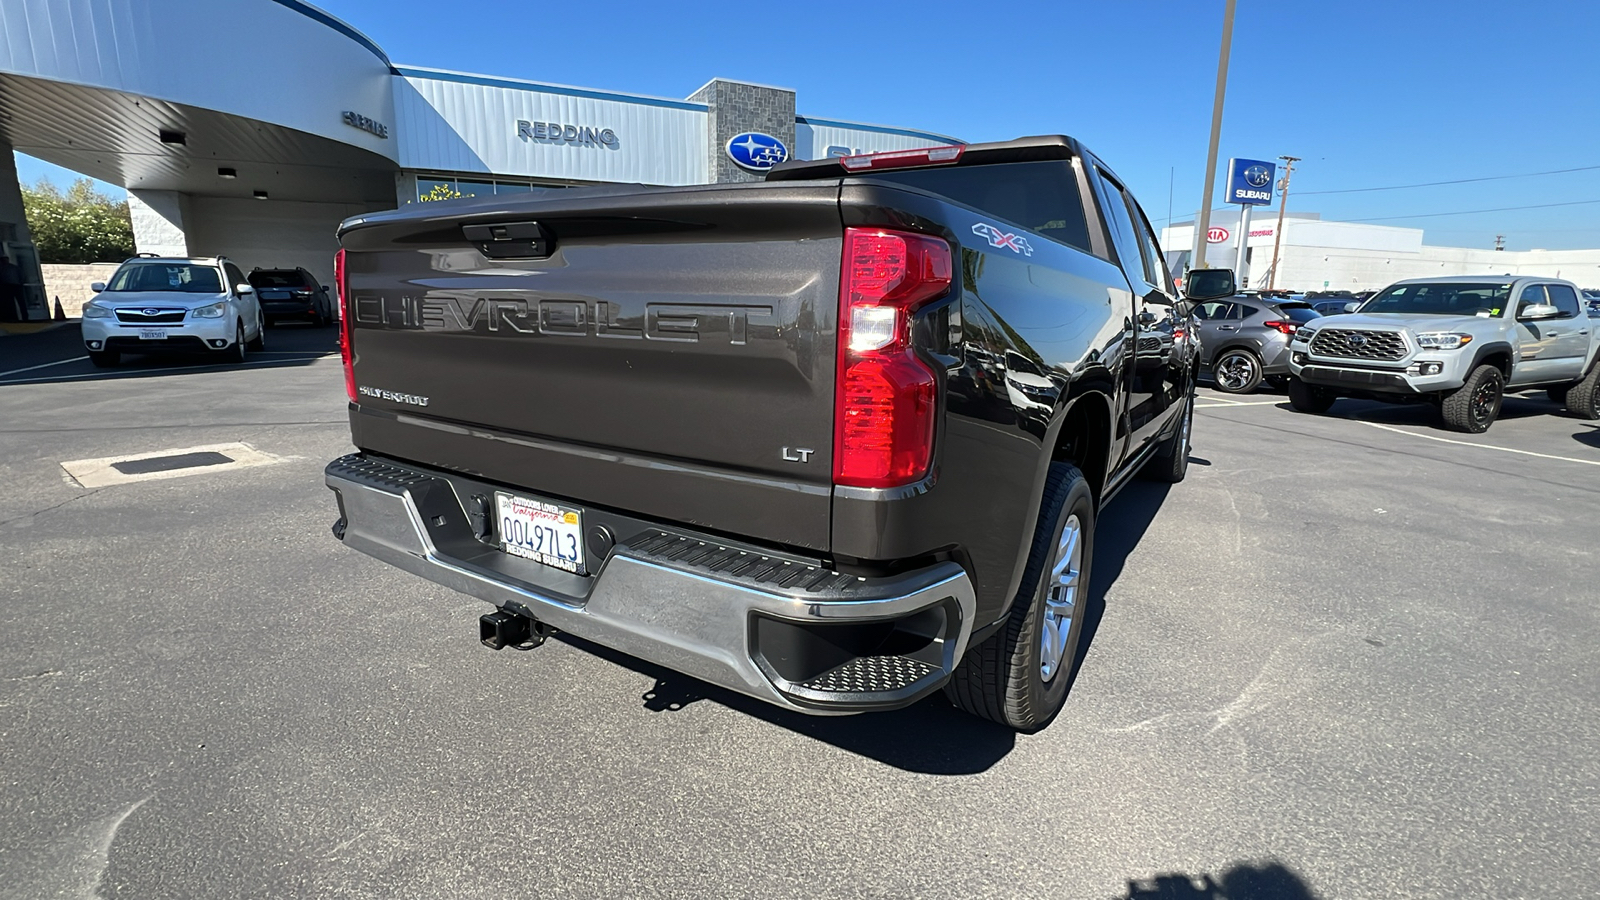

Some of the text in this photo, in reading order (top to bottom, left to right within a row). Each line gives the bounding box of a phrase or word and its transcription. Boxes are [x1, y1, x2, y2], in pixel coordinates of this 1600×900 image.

[516, 119, 617, 147] REDDING
[1235, 189, 1271, 201] SUBARU
[354, 294, 774, 346] CHEVROLET
[359, 386, 430, 407] SILVERADO
[782, 446, 815, 463] LT
[541, 502, 559, 514] LOVER
[504, 517, 578, 562] 00497L3
[506, 543, 577, 572] REDDING SUBARU
